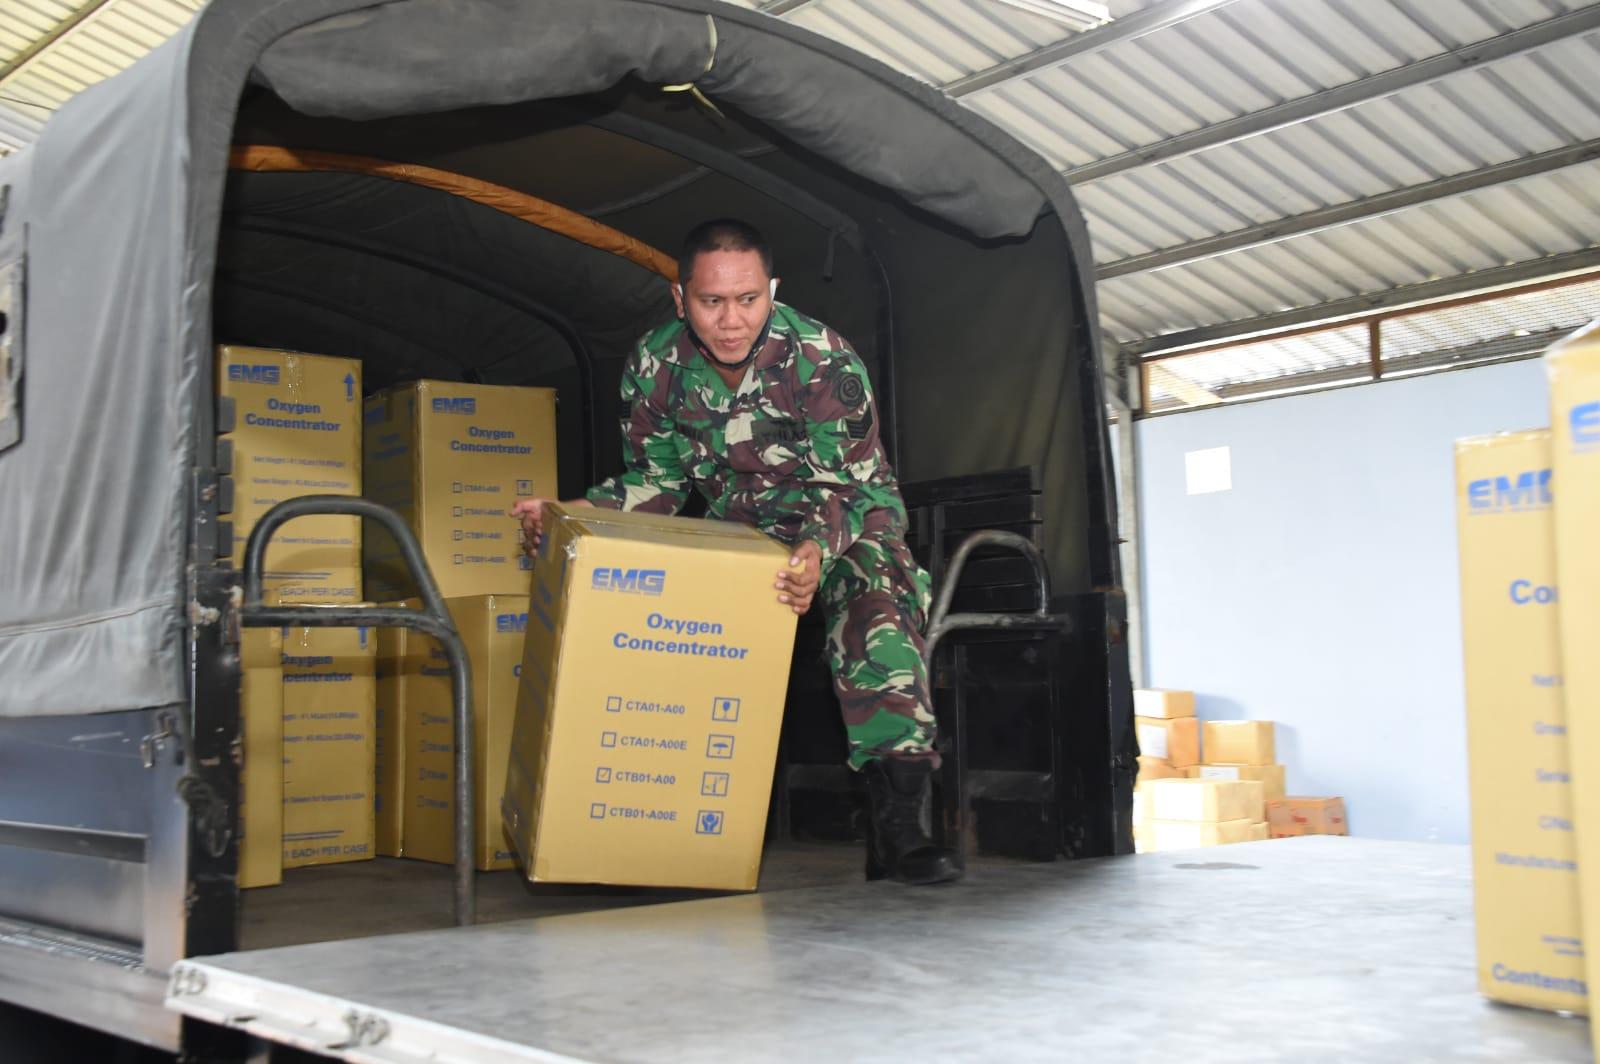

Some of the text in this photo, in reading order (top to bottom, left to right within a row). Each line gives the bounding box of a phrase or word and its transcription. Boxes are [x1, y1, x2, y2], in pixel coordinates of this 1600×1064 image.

[228, 364, 280, 385] EMG
[267, 398, 321, 416] Oxygen
[432, 397, 476, 415] EMG
[245, 412, 341, 433] Concentrator
[469, 426, 516, 441] Oxygen
[450, 439, 533, 455] Concentrator
[592, 568, 666, 593] EMG
[496, 613, 528, 632] EM
[647, 613, 724, 636] Oxygen
[614, 632, 749, 660] Concentrator
[625, 699, 686, 715] CTA01-A00
[620, 735, 688, 752] CTA01-A00E
[615, 770, 676, 786] CTB01-A00
[609, 805, 678, 822] CTB01-A00E
